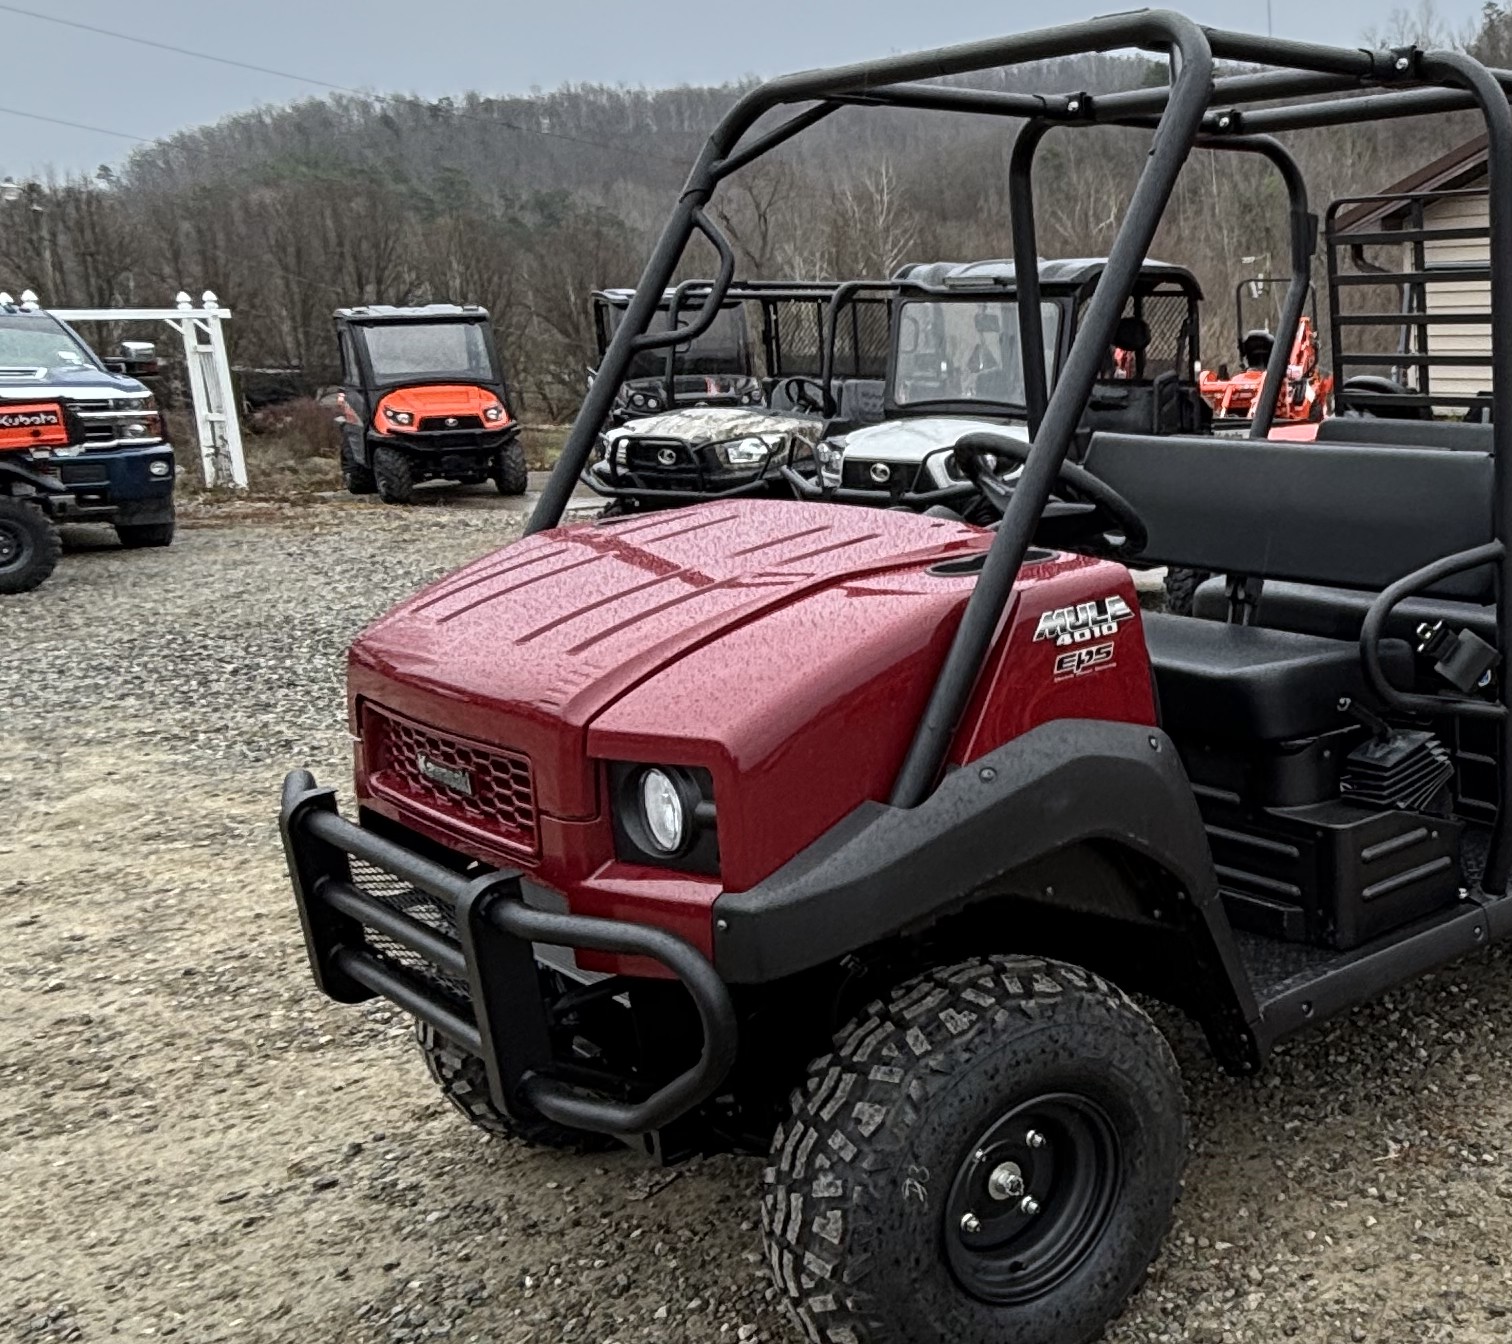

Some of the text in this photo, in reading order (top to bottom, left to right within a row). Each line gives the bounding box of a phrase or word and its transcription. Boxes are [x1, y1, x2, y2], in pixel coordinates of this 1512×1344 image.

[1032, 595, 1135, 642] MULE
[1056, 622, 1118, 646] 4010
[1054, 641, 1114, 674] EPS
